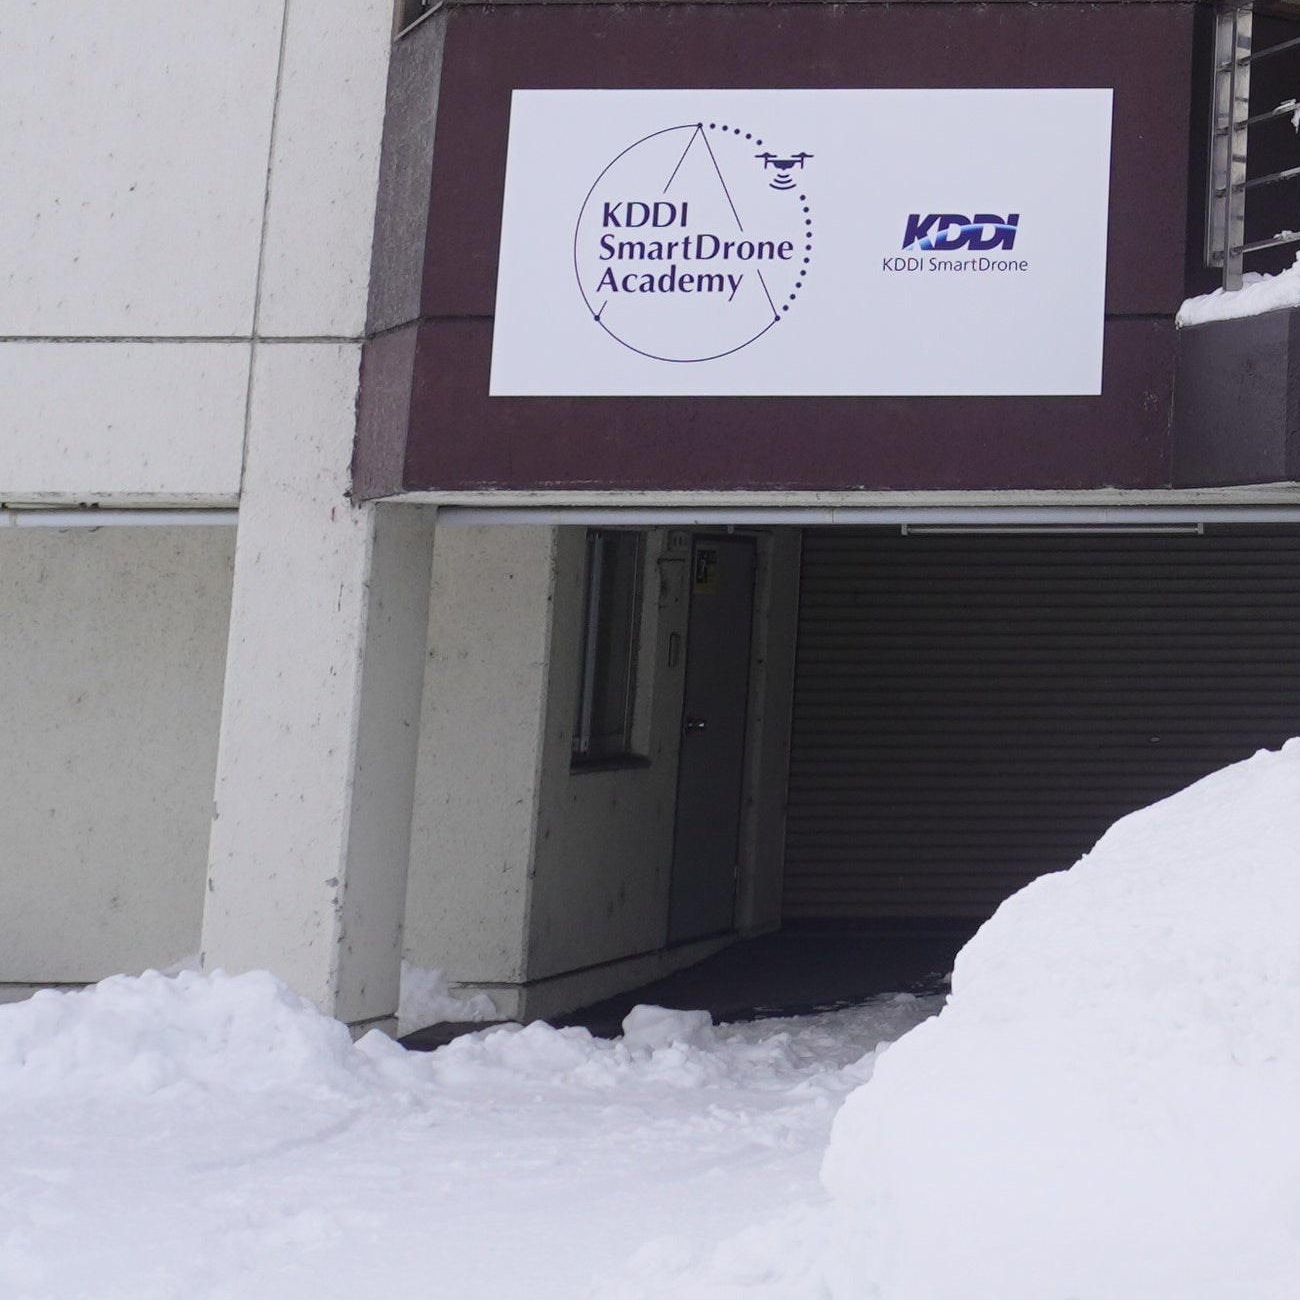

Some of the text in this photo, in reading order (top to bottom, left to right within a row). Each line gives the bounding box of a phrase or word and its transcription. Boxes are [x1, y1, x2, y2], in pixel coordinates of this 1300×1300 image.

[602, 201, 689, 228] KDDI
[902, 213, 1020, 251] KDDI
[599, 233, 794, 261] SmartDrone
[882, 257, 1029, 272] KDDI SmartDrone
[596, 264, 744, 302] Academy
